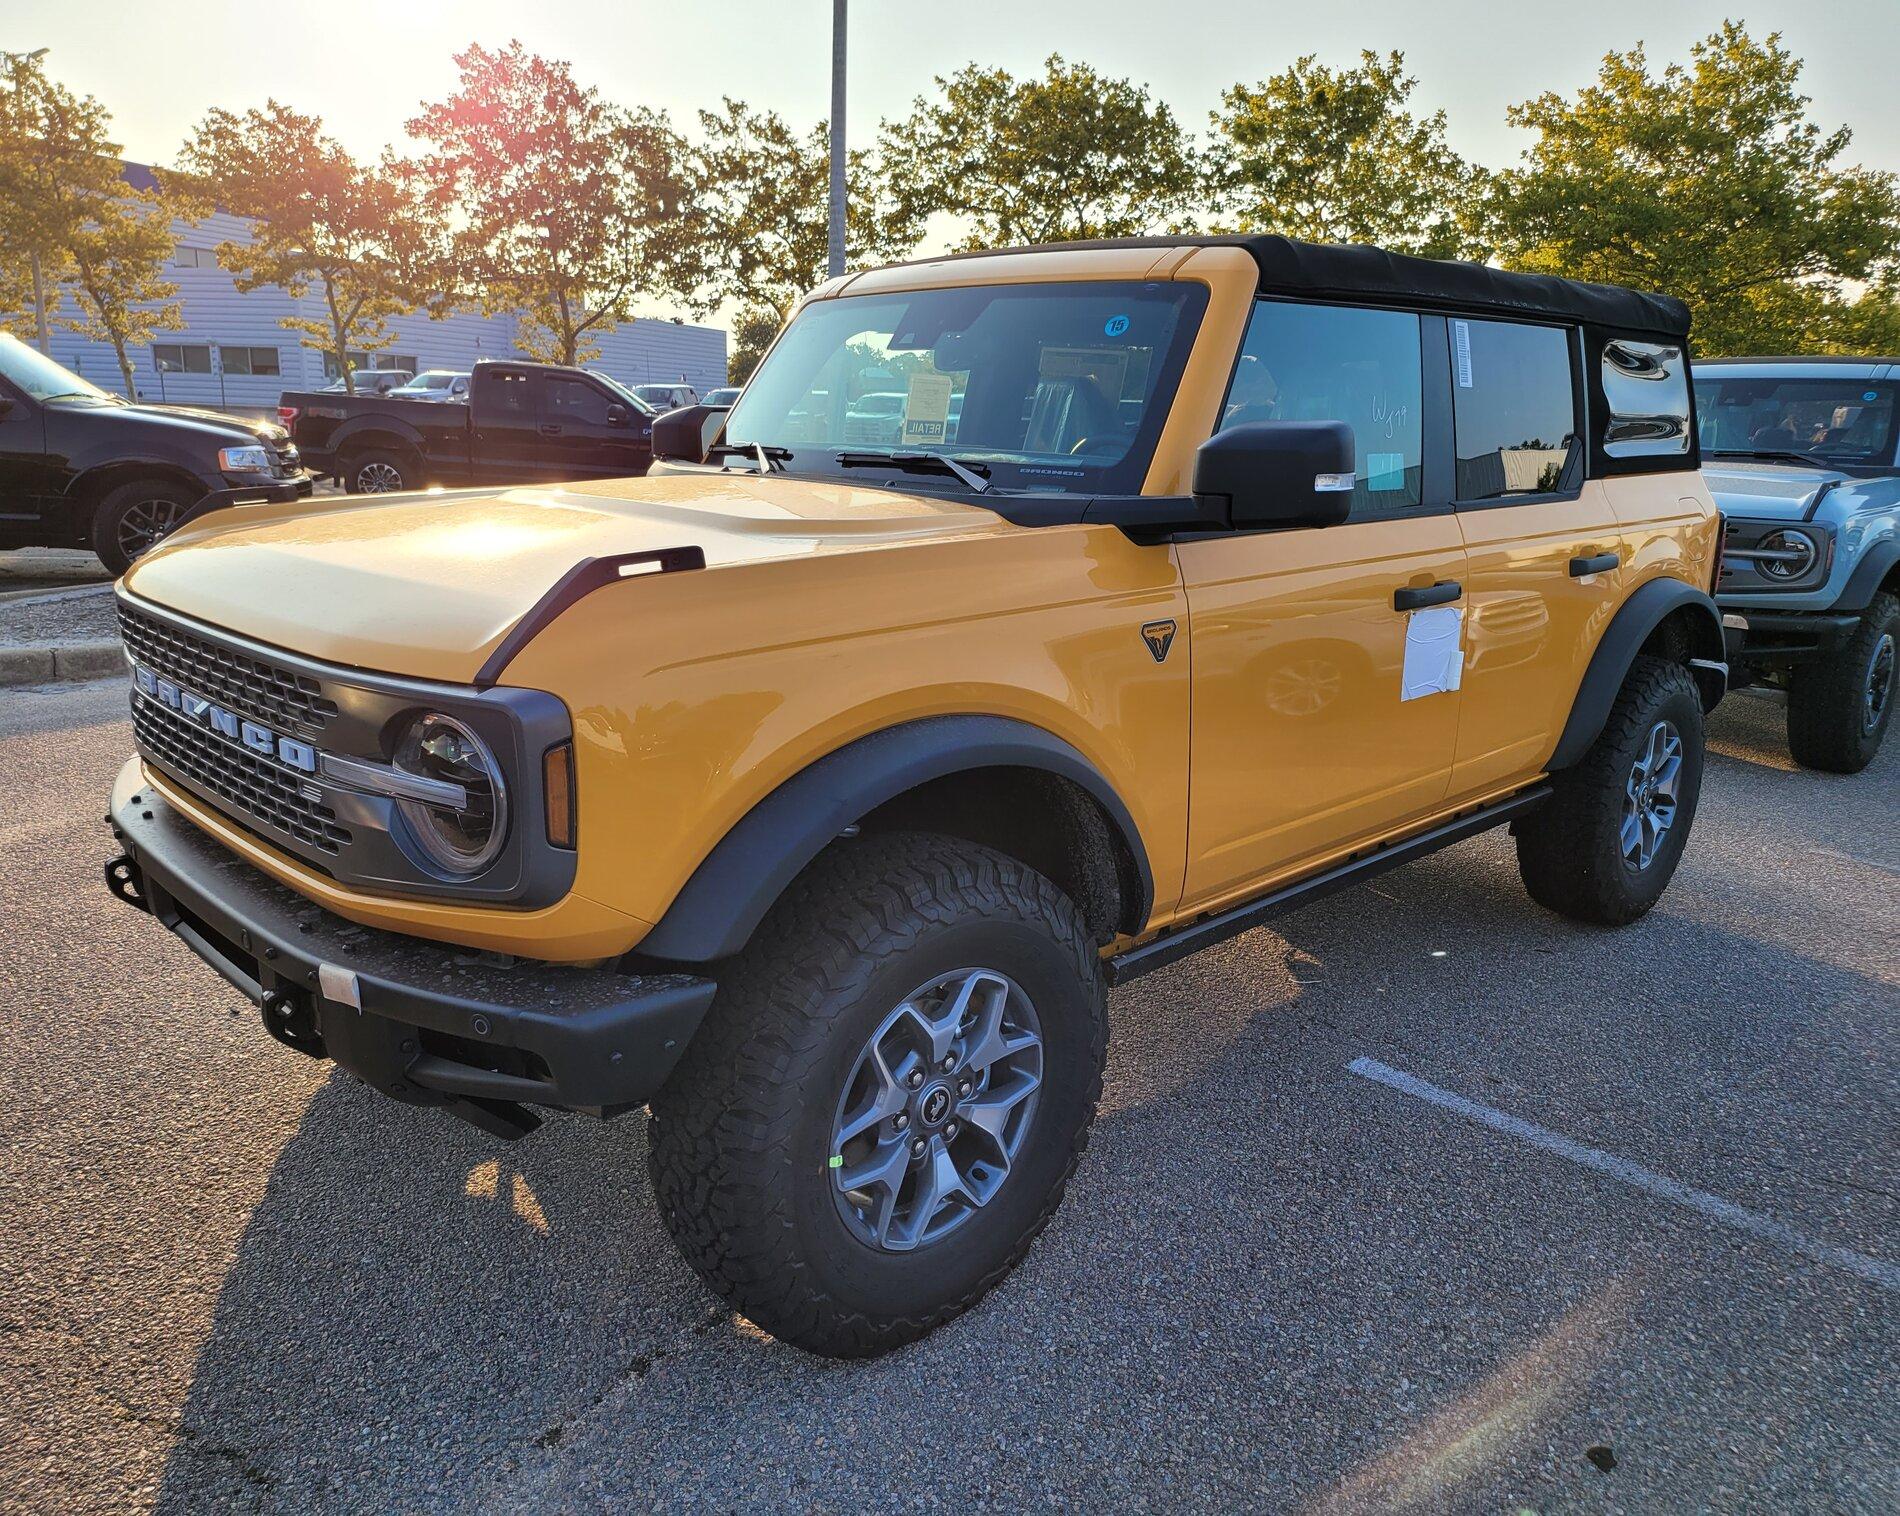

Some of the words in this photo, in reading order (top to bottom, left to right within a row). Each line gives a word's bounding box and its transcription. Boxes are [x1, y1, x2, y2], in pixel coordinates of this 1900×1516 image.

[1110, 319, 1126, 332] 15
[1019, 468, 1085, 477] BRONCO
[137, 665, 315, 772] BRONCO
